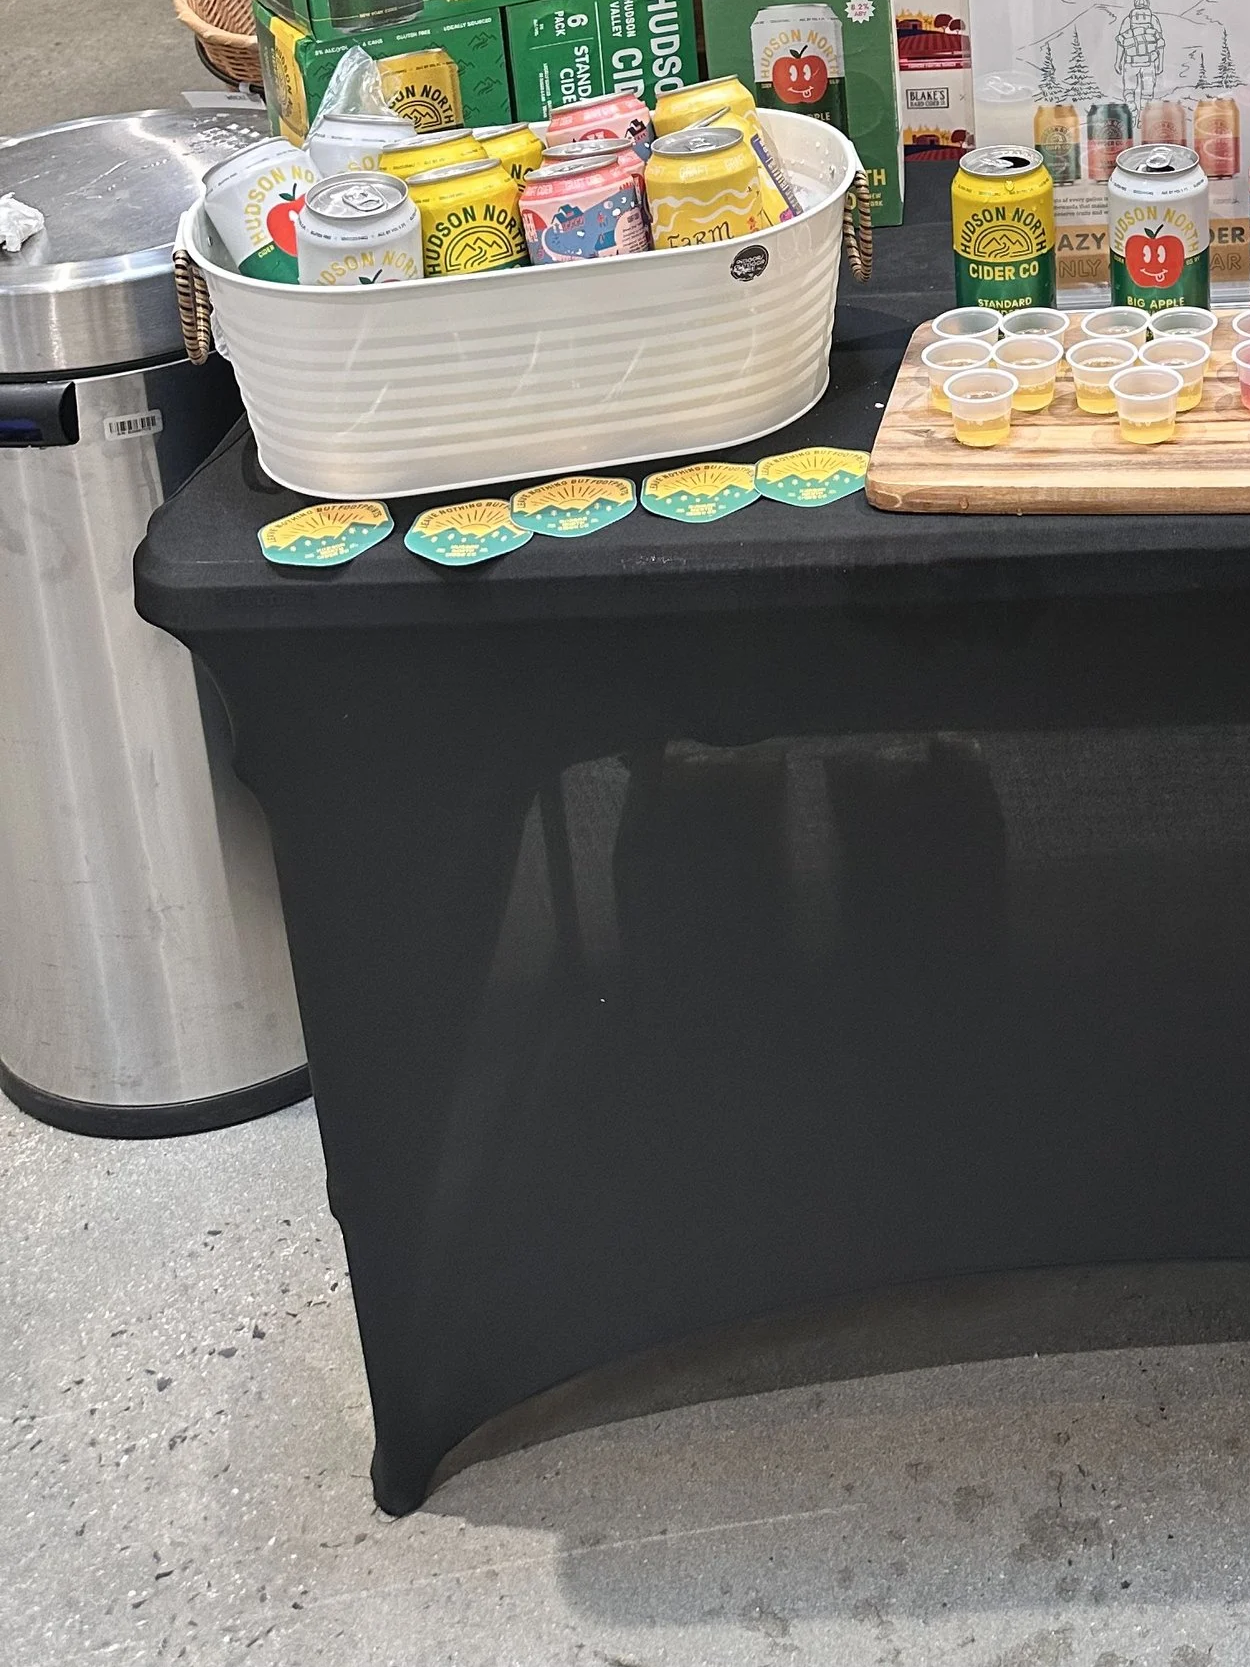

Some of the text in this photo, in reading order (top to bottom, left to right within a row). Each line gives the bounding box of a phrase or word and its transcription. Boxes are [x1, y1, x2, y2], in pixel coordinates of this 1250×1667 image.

[554, 10, 566, 36] PACK
[567, 14, 588, 27] 6
[610, 1, 622, 38] VALLEY
[910, 90, 945, 101] BLAKE'S
[245, 168, 287, 245] HUDSON
[960, 206, 1006, 253] HUDSON
[1012, 207, 1047, 253] NORTH
[1114, 207, 1198, 253] HUDSON NORTH
[426, 204, 527, 276] HUDSON NORTH
[1058, 233, 1106, 251] AZY
[258, 245, 275, 258] CIDER
[970, 261, 1039, 281] CIDER CO
[1059, 260, 1102, 278] NLY
[978, 298, 1032, 308] STANDARD
[1128, 296, 1185, 309] BIG APPLE
[317, 505, 337, 513] BUT
